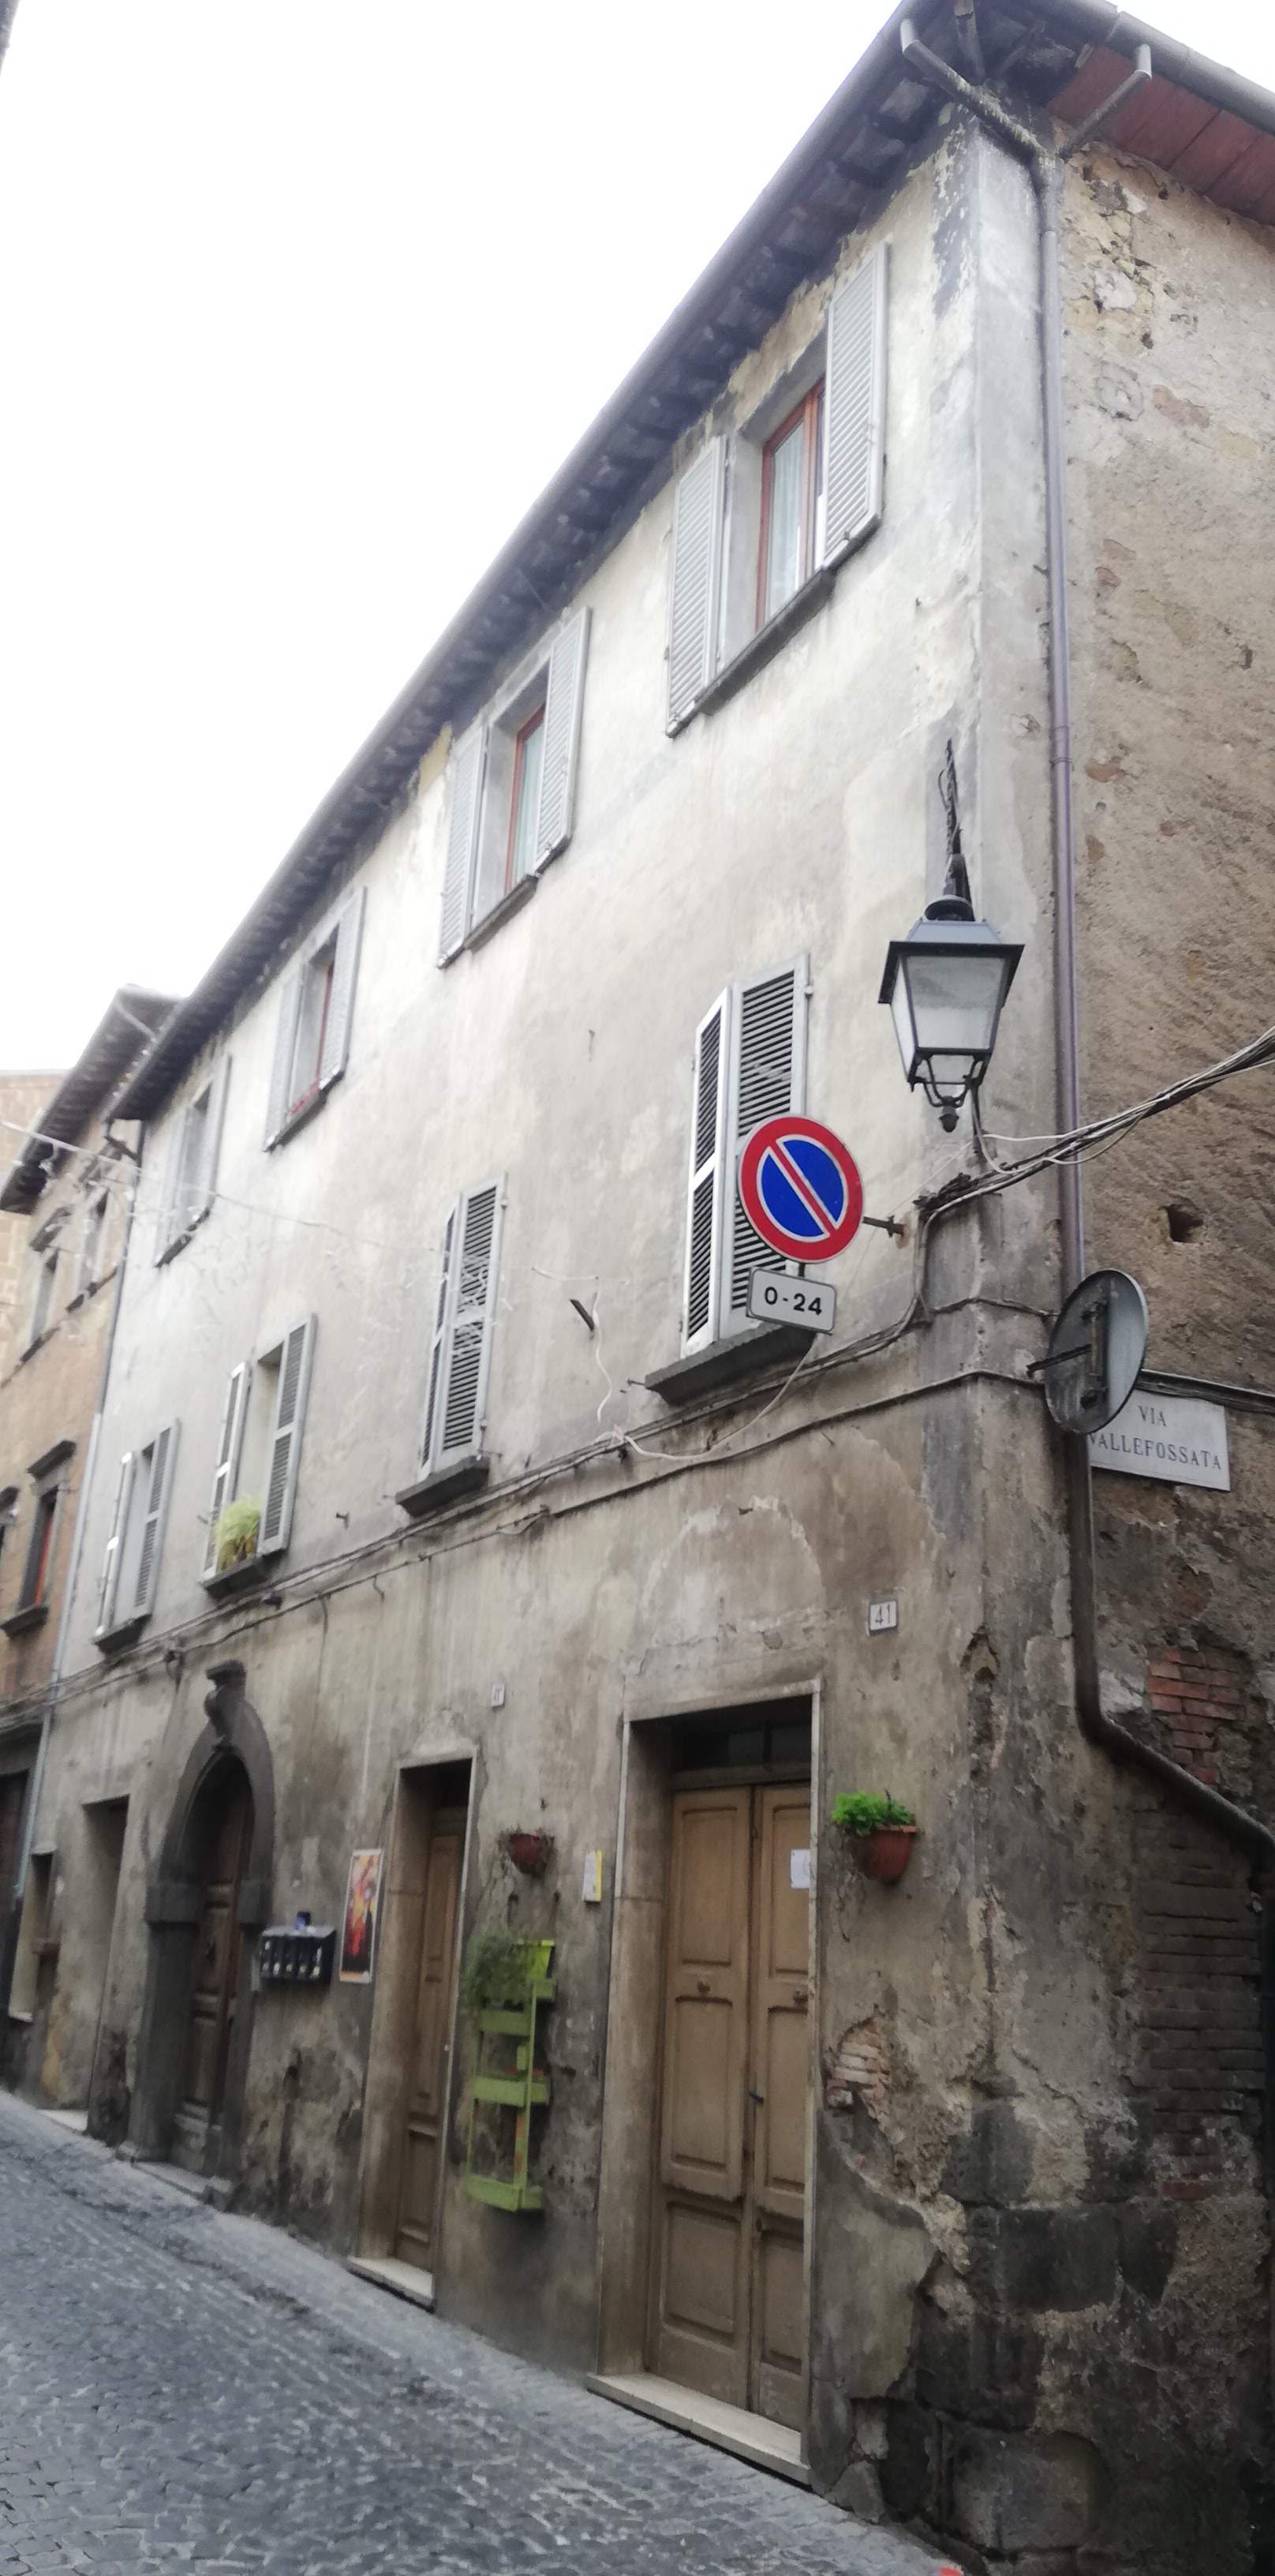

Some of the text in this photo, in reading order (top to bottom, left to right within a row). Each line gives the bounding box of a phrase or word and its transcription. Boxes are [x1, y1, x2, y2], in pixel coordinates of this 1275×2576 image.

[765, 1286, 822, 1316] 0-24
[1137, 1405, 1167, 1427] VIA
[1089, 1432, 1221, 1470] VALLEFOSSATA
[875, 1604, 891, 1626] 41
